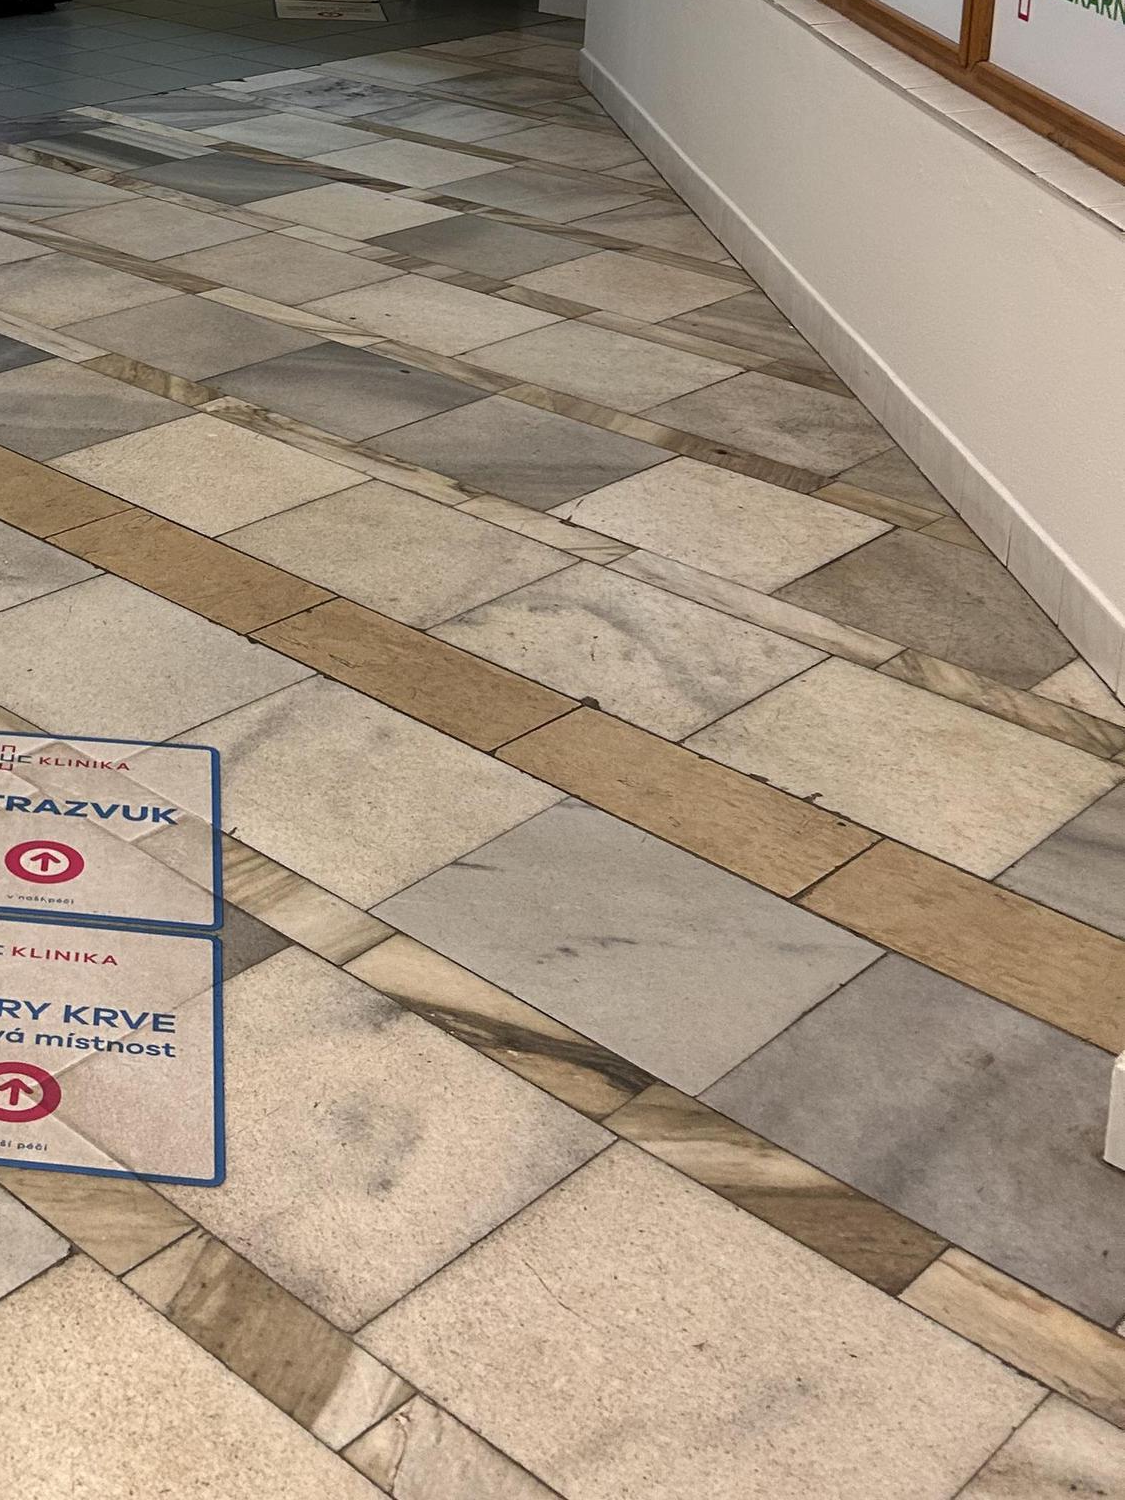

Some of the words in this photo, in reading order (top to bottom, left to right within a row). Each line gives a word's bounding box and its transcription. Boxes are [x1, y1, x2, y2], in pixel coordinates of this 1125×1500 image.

[39, 756, 130, 772] KLINIKA
[11, 946, 118, 966] KLINIKA
[63, 1004, 176, 1034] KRVE
[34, 1030, 177, 1058] místnost
[16, 1141, 48, 1152] péči
